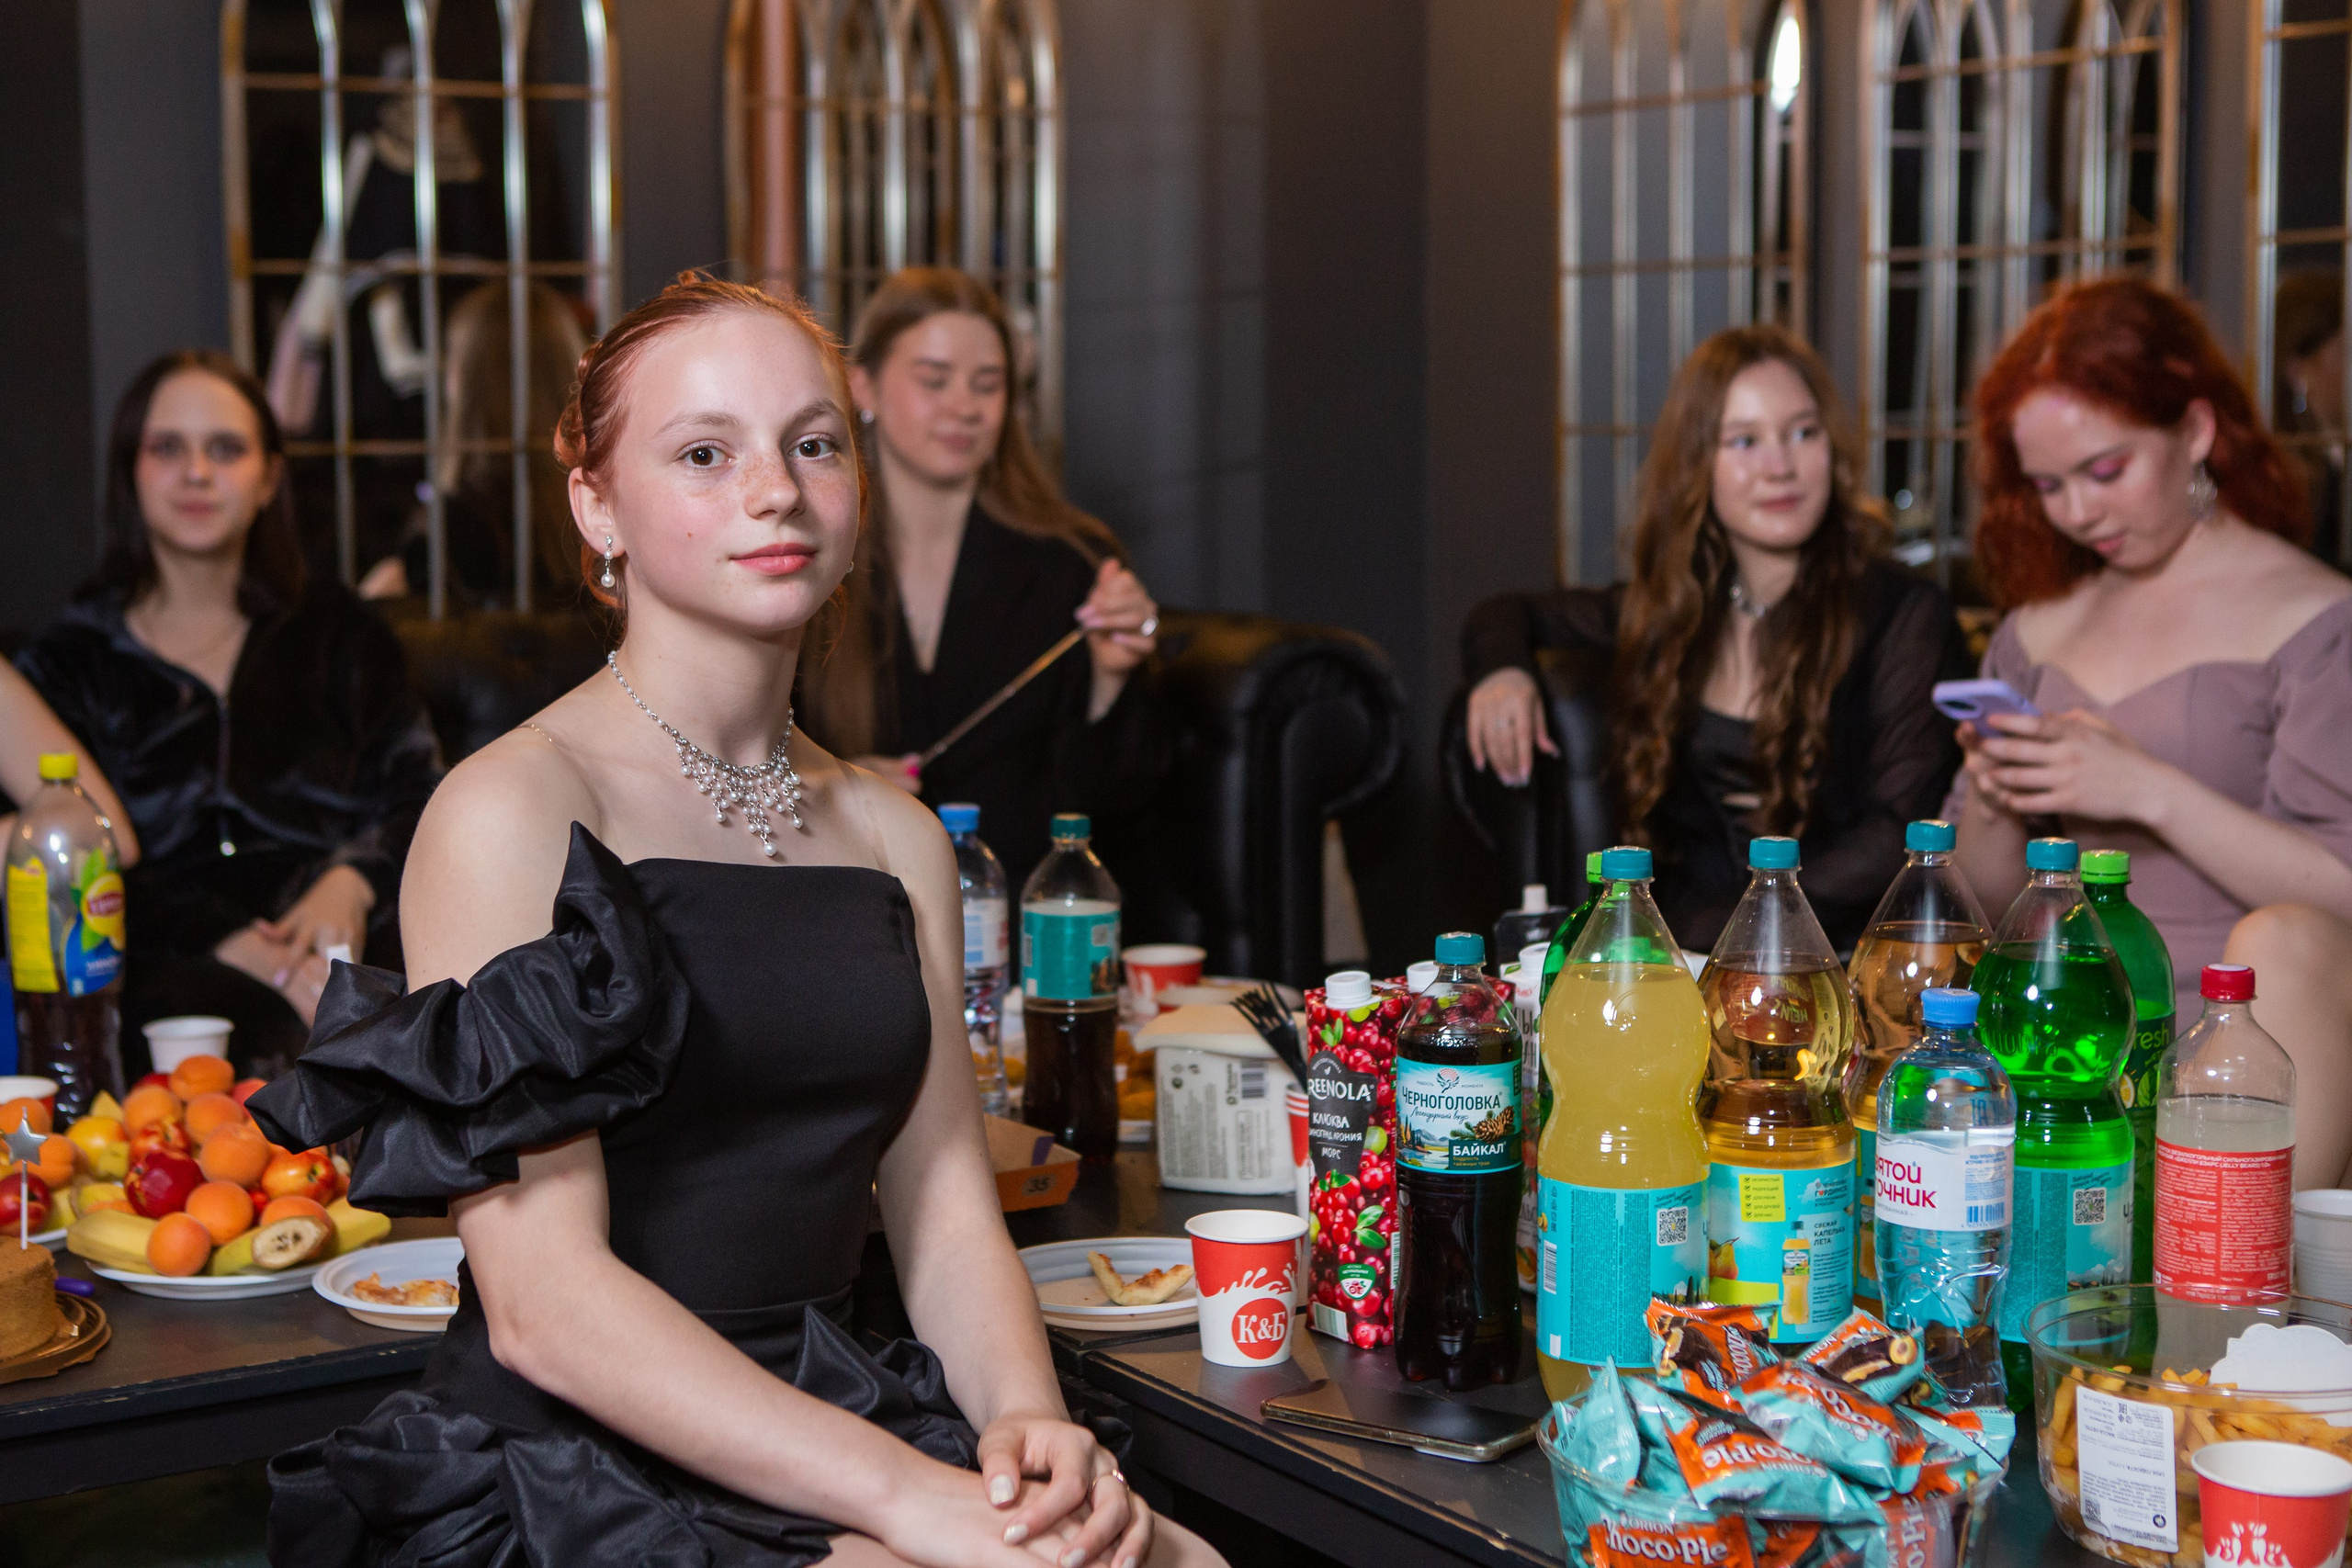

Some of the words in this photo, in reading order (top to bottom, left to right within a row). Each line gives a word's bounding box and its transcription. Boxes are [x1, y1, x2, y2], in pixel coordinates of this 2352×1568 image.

[2133, 1021, 2169, 1050] resh
[1307, 1078, 1372, 1102] REENOLA
[1402, 1086, 1500, 1111] ЧЕРНОГОЛОВКА
[1313, 1112, 1350, 1128] КЛЮКВА
[1321, 1146, 1341, 1160] МОРС
[1453, 1143, 1504, 1156] БАЙКАЛ
[1027, 1178, 1049, 1193] 35
[1875, 1177, 1938, 1209] ОЧНИК
[1814, 1220, 1838, 1229] СВЕЖАЯ
[1814, 1226, 1846, 1237] КАПЕЛЬКА
[1237, 1312, 1285, 1344] К&Б
[1629, 1518, 1675, 1536] ORION
